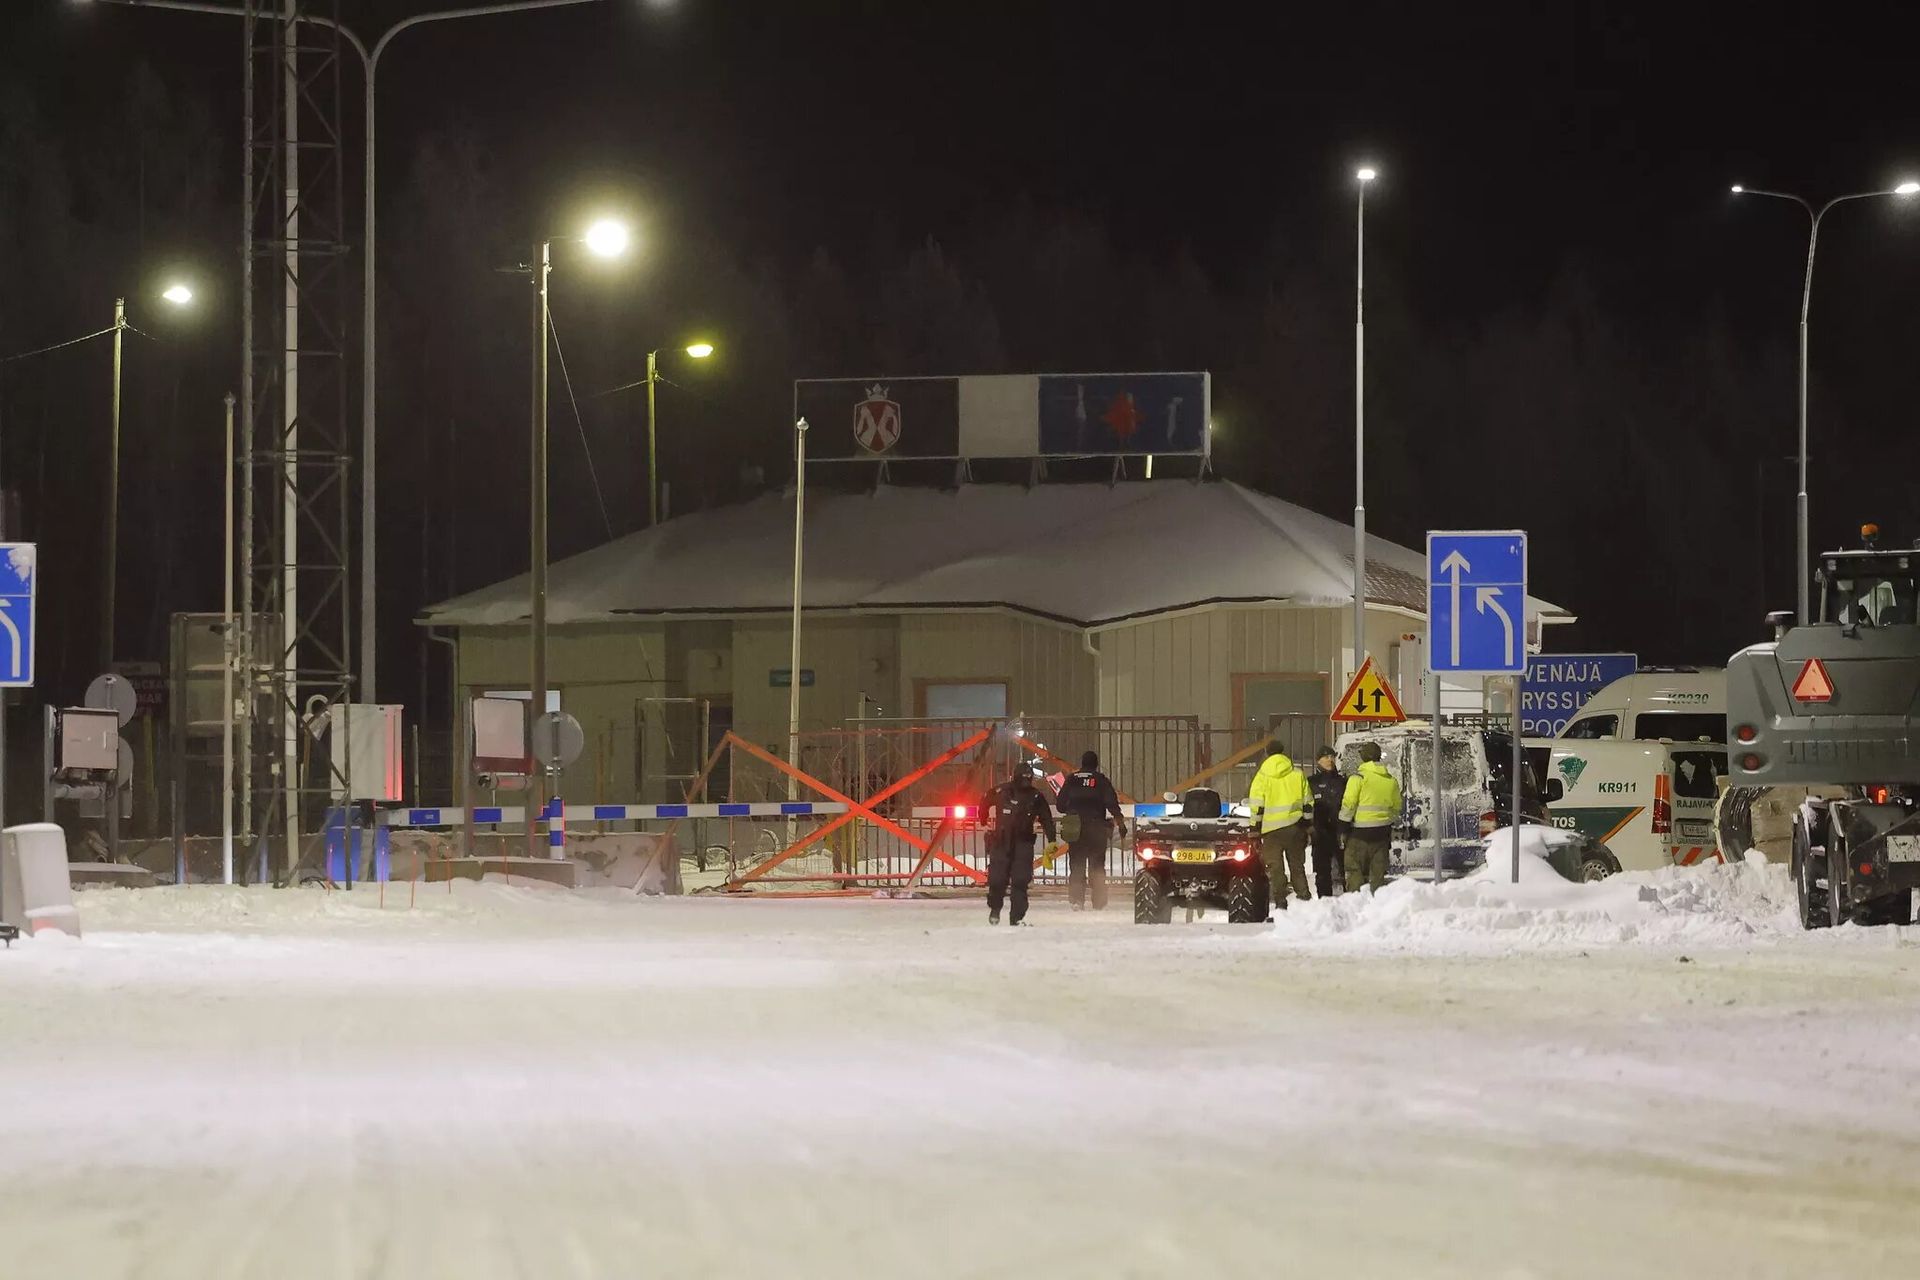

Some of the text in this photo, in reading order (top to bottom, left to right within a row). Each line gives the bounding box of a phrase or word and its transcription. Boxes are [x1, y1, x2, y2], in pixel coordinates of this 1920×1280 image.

[1524, 661, 1602, 683] VENÄJÄ
[1522, 691, 1585, 710] RYSSL
[1598, 782, 1637, 793] KR911
[1551, 816, 1576, 828] TOS
